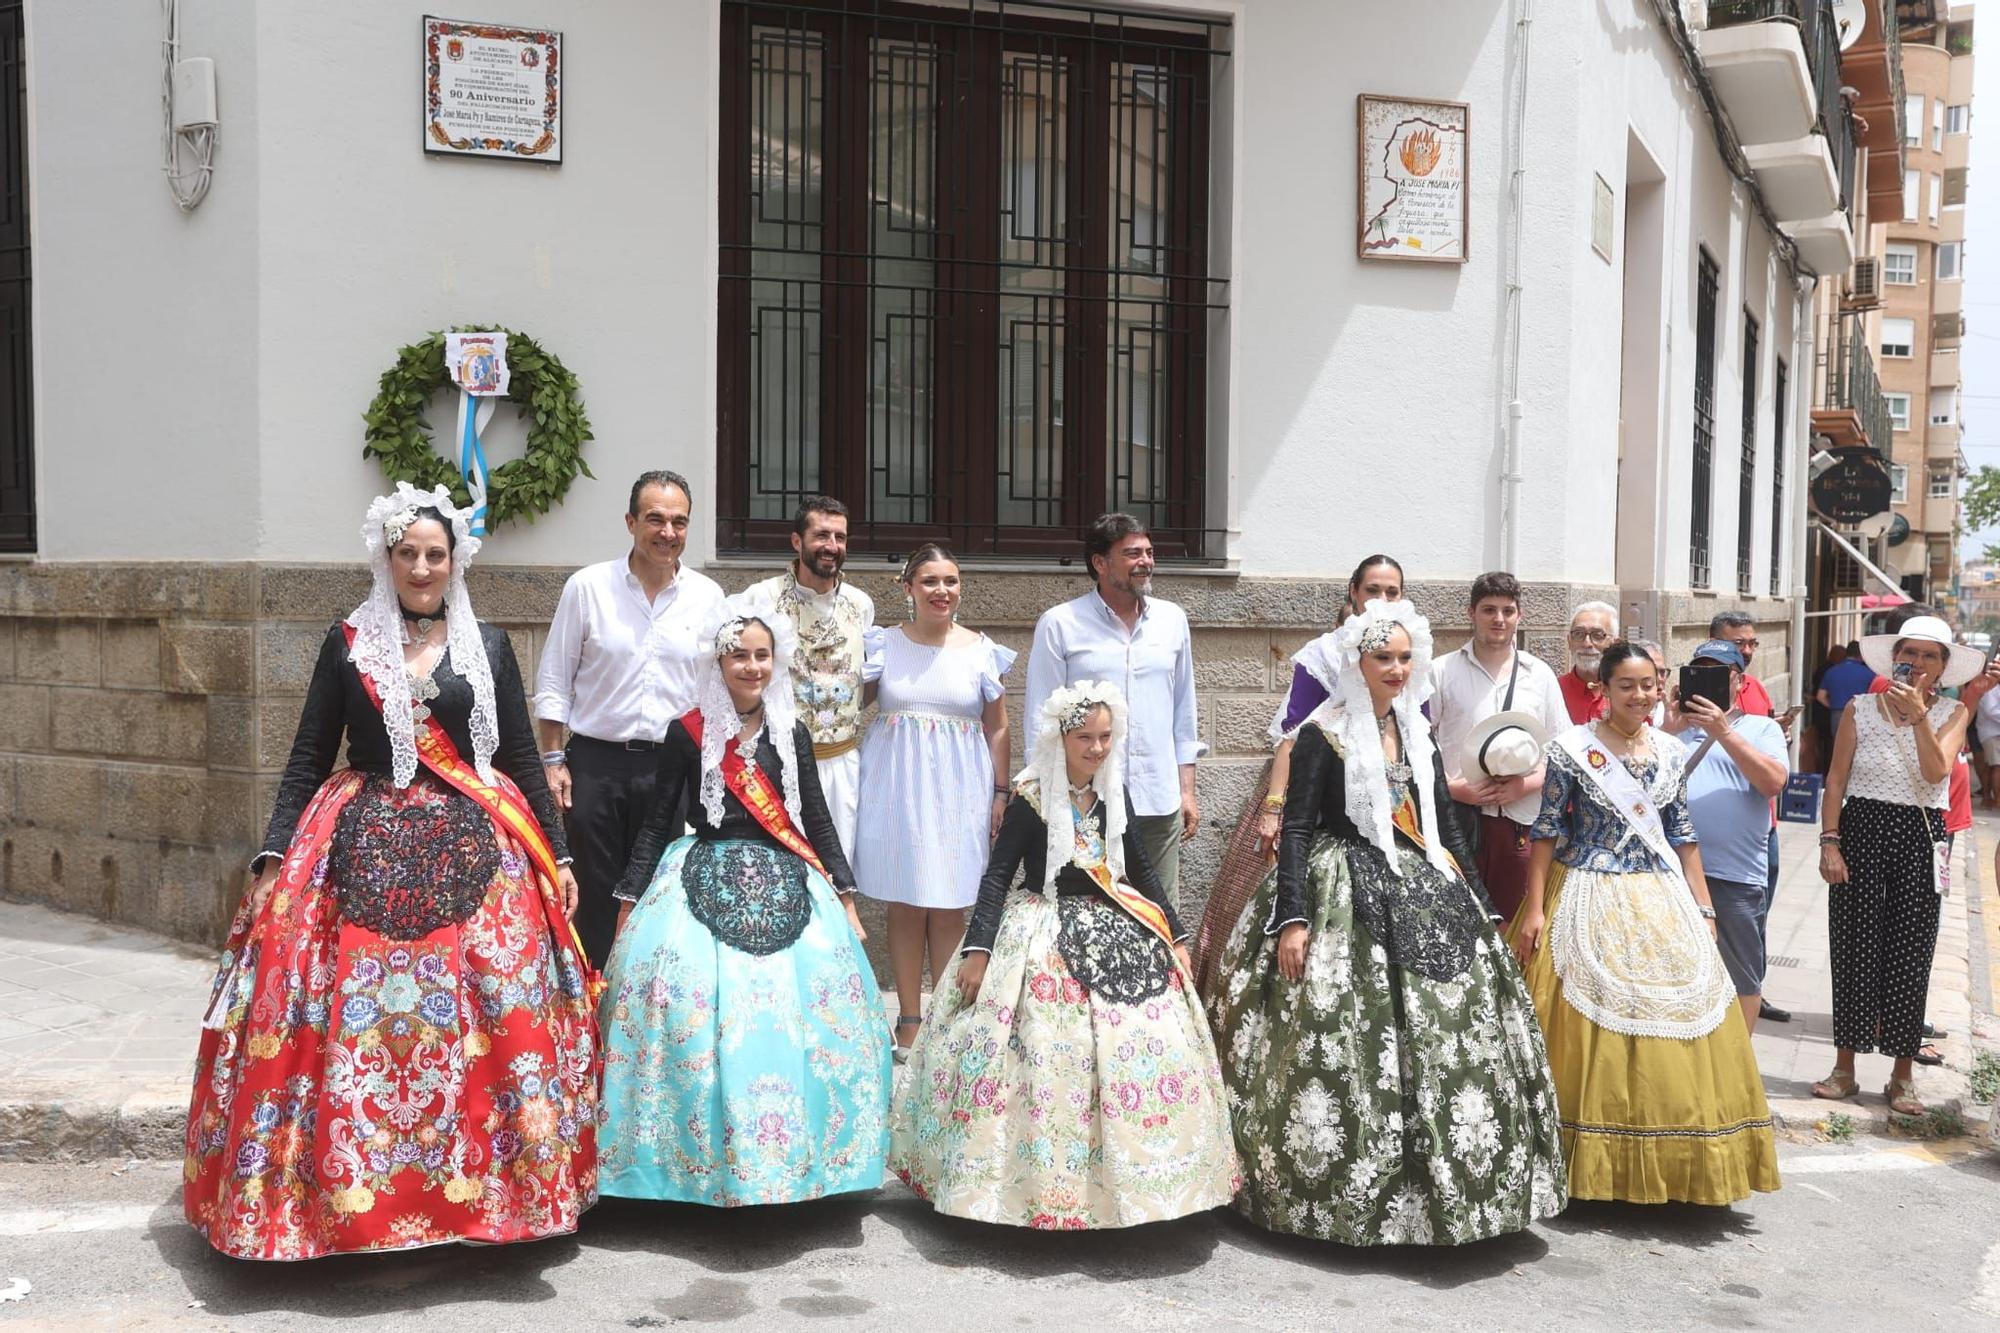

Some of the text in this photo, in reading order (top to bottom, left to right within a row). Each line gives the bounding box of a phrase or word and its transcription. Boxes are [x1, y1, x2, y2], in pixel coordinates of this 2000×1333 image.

[483, 57, 513, 65] ALICANTE
[449, 89, 536, 106] 90 Aniversario
[1399, 178, 1405, 188] A
